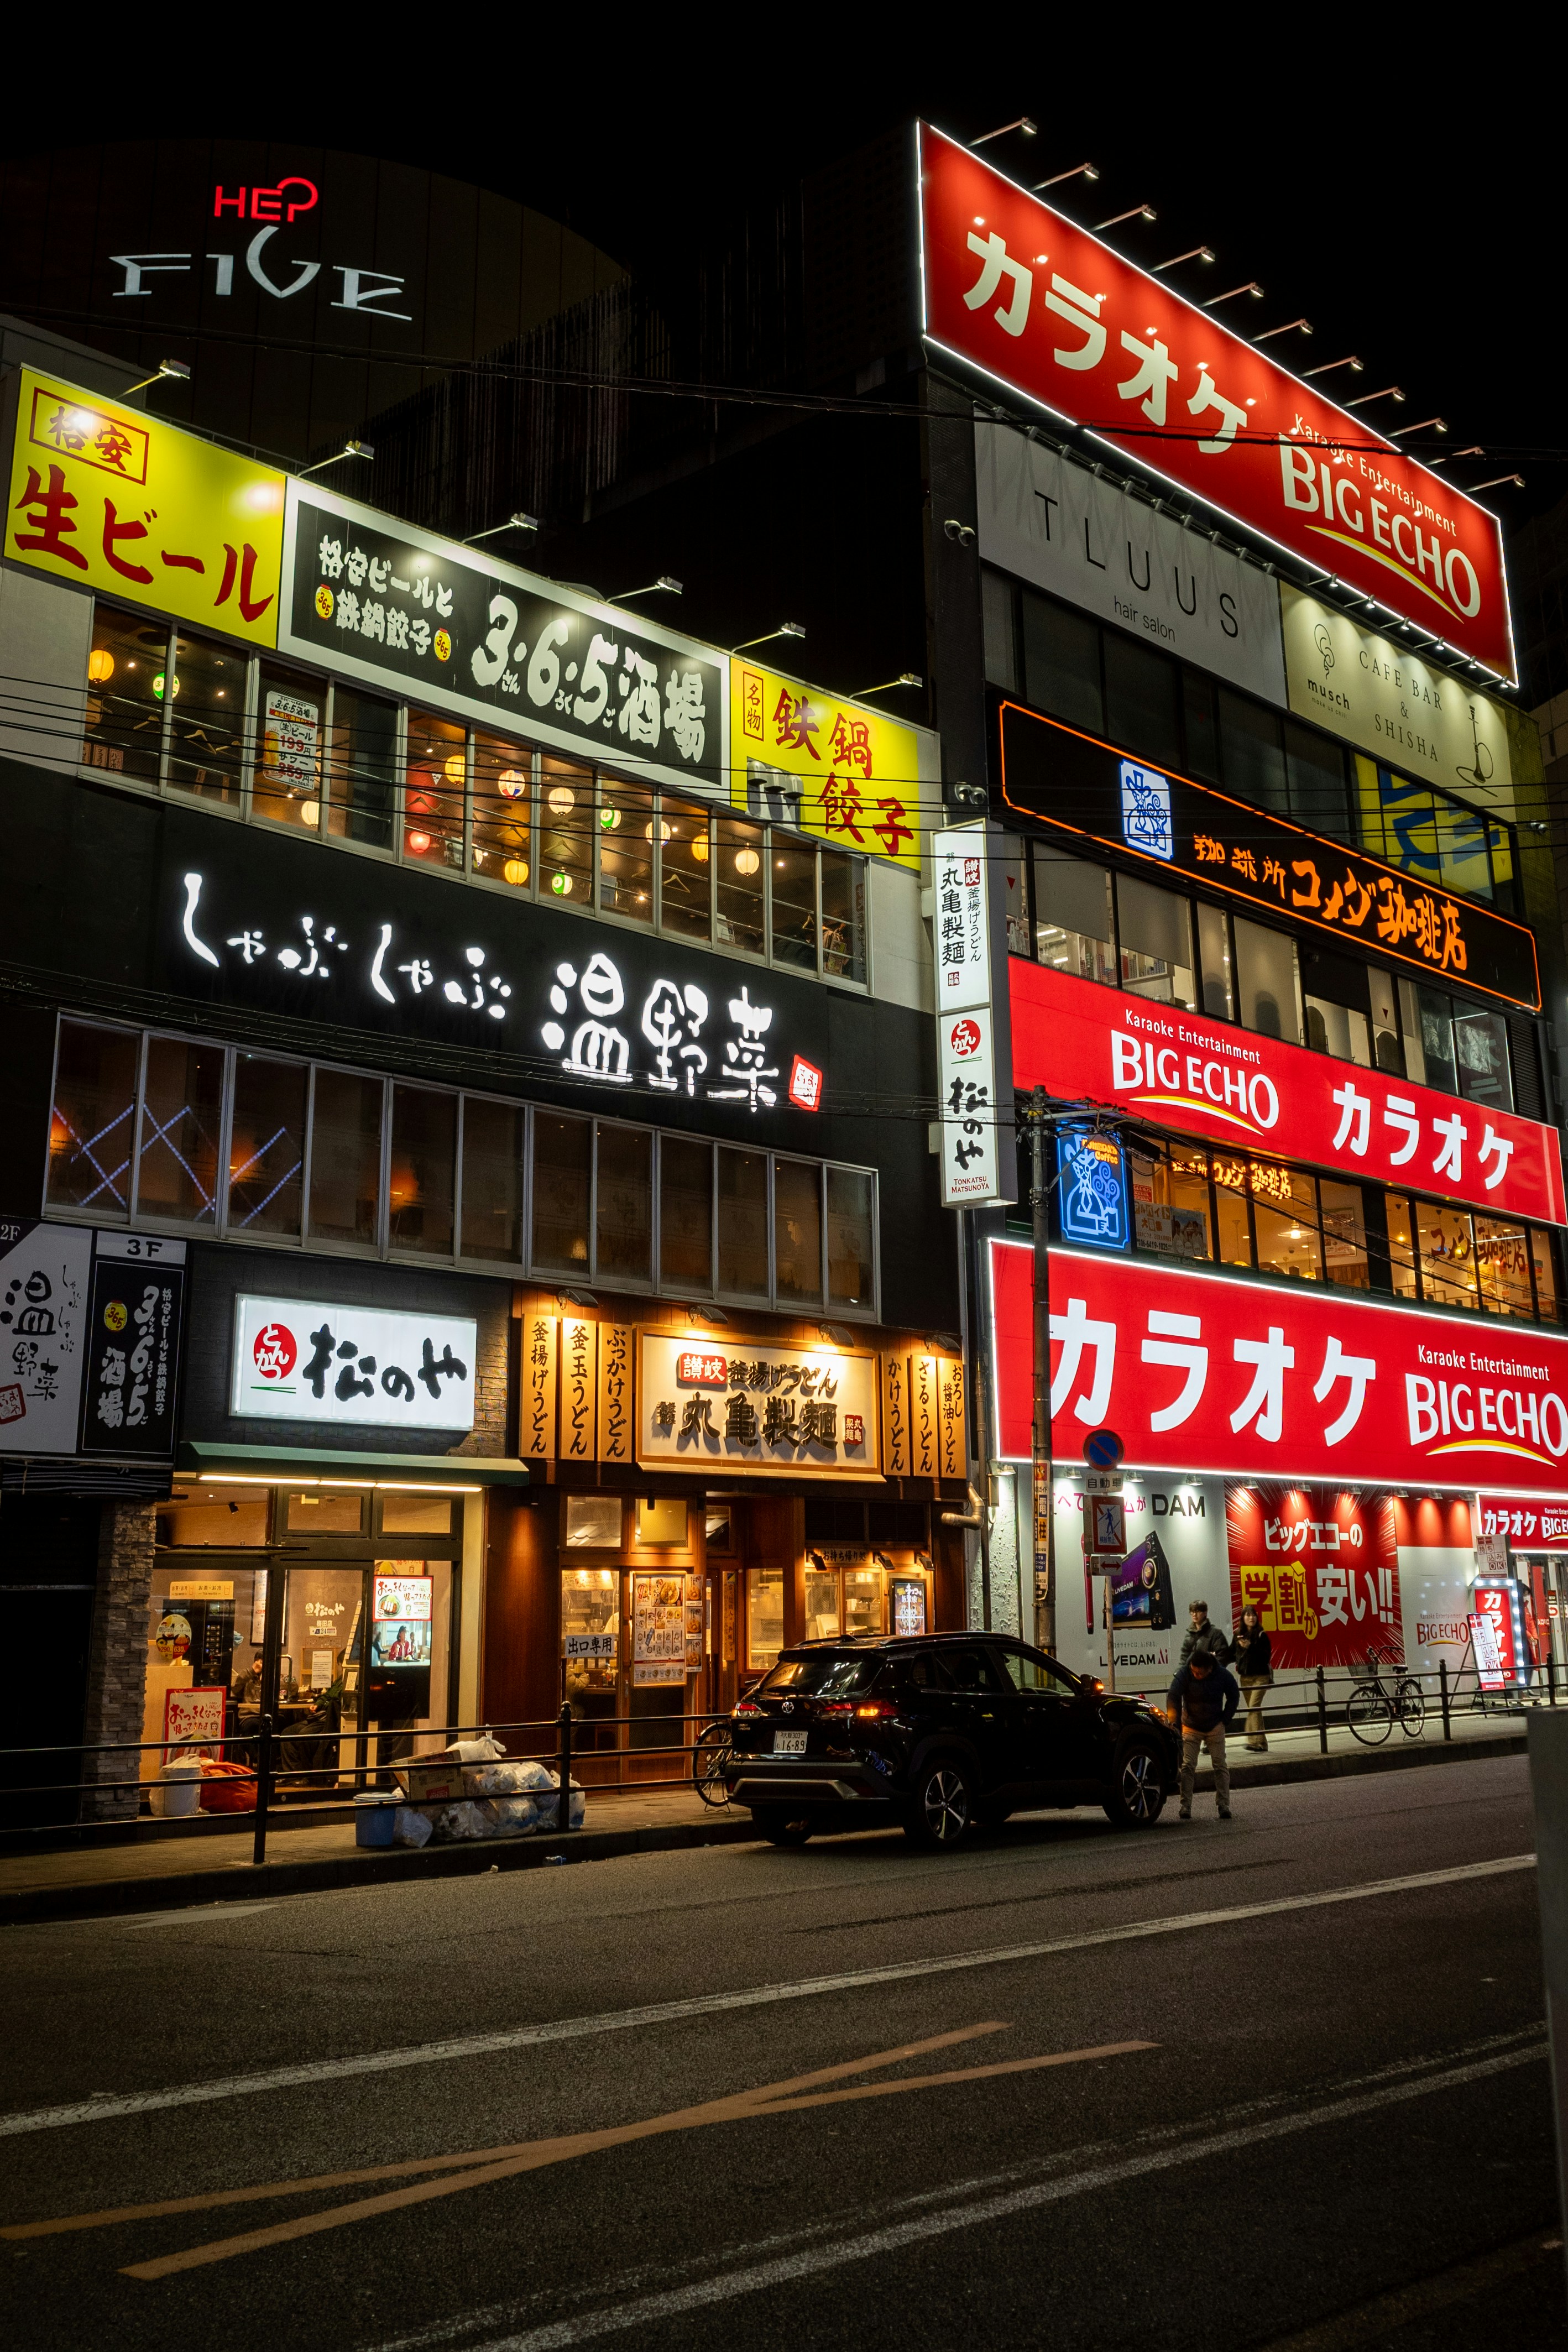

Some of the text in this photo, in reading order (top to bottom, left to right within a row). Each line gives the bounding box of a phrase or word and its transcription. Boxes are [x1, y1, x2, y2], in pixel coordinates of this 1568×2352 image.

[215, 177, 318, 222] HEP
[108, 225, 412, 321] FIVE
[963, 231, 1247, 454] カラオケ
[48, 406, 133, 471] 格安
[1295, 413, 1457, 537] Karaoke Entertainment
[14, 464, 275, 623] 生ビール
[1278, 432, 1481, 618] BIG ECHO
[319, 535, 453, 617] 格安ビールと
[1034, 490, 1238, 638] TLUUS
[317, 592, 331, 616] 365
[336, 588, 431, 656] 鉄鍋餃子
[1114, 595, 1175, 643] hair salon
[436, 635, 448, 658] 365
[746, 682, 760, 732] 名物
[1308, 678, 1350, 710] musch
[1359, 650, 1442, 712] CAFE BAR
[1400, 701, 1408, 718] &
[772, 688, 872, 779] 鉄鍋
[1374, 714, 1438, 762] SHISHA
[817, 772, 914, 856] 餃子
[965, 859, 979, 884] 讃岐
[940, 867, 965, 966] 丸亀製麺
[967, 887, 981, 963] 釜揚げうどん
[1292, 860, 1467, 970] コメダ珈琲店
[184, 872, 779, 1112] しゃぶしゃぶ 温野菜
[1125, 1008, 1261, 1065] Karaoke Entertainment
[1111, 1029, 1279, 1128] BIG ECHO
[948, 1076, 988, 1170] 松のや
[1332, 1081, 1513, 1190] カラオケ
[1, 1225, 20, 1242] 2F
[1, 1270, 59, 1401] 温野菜
[255, 1324, 290, 1380] とんかつ
[302, 1323, 468, 1402] 松のや
[1418, 1344, 1550, 1381] Karaoke Entertainment
[97, 1346, 126, 1428] 酒場
[530, 1321, 549, 1454] 釜揚げうどん
[569, 1325, 590, 1455] 釜玉うどん
[607, 1329, 627, 1458] ぶっかけうどん
[683, 1355, 838, 1397] 讃岐 釜揚げうどん
[953, 1364, 963, 1418] おろし
[1050, 1298, 1376, 1447] カラオケ
[678, 1391, 838, 1450] 丸亀製麺
[887, 1357, 905, 1472] かけうどん
[918, 1362, 933, 1473] ざるうどん
[943, 1383, 957, 1474] 醤油うどん
[1405, 1373, 1568, 1457] BIG ECHO
[1088, 1478, 1122, 1488] 自動車
[1152, 1494, 1205, 1517] DAM
[1264, 1517, 1363, 1553] ビッグエコーの
[1485, 1509, 1537, 1536] カラオケ
[1541, 1516, 1561, 1538] BIG
[824, 1550, 867, 1562] お持ち帰り処
[314, 1602, 345, 1617] 松のや
[1417, 1623, 1437, 1645] BIG
[1439, 1622, 1468, 1643] ECHO
[568, 1637, 613, 1655] 出口専用
[1100, 1654, 1156, 1666] LVEDAM
[169, 1703, 222, 1724] おっきくなって
[782, 1740, 805, 1751] 16-89
